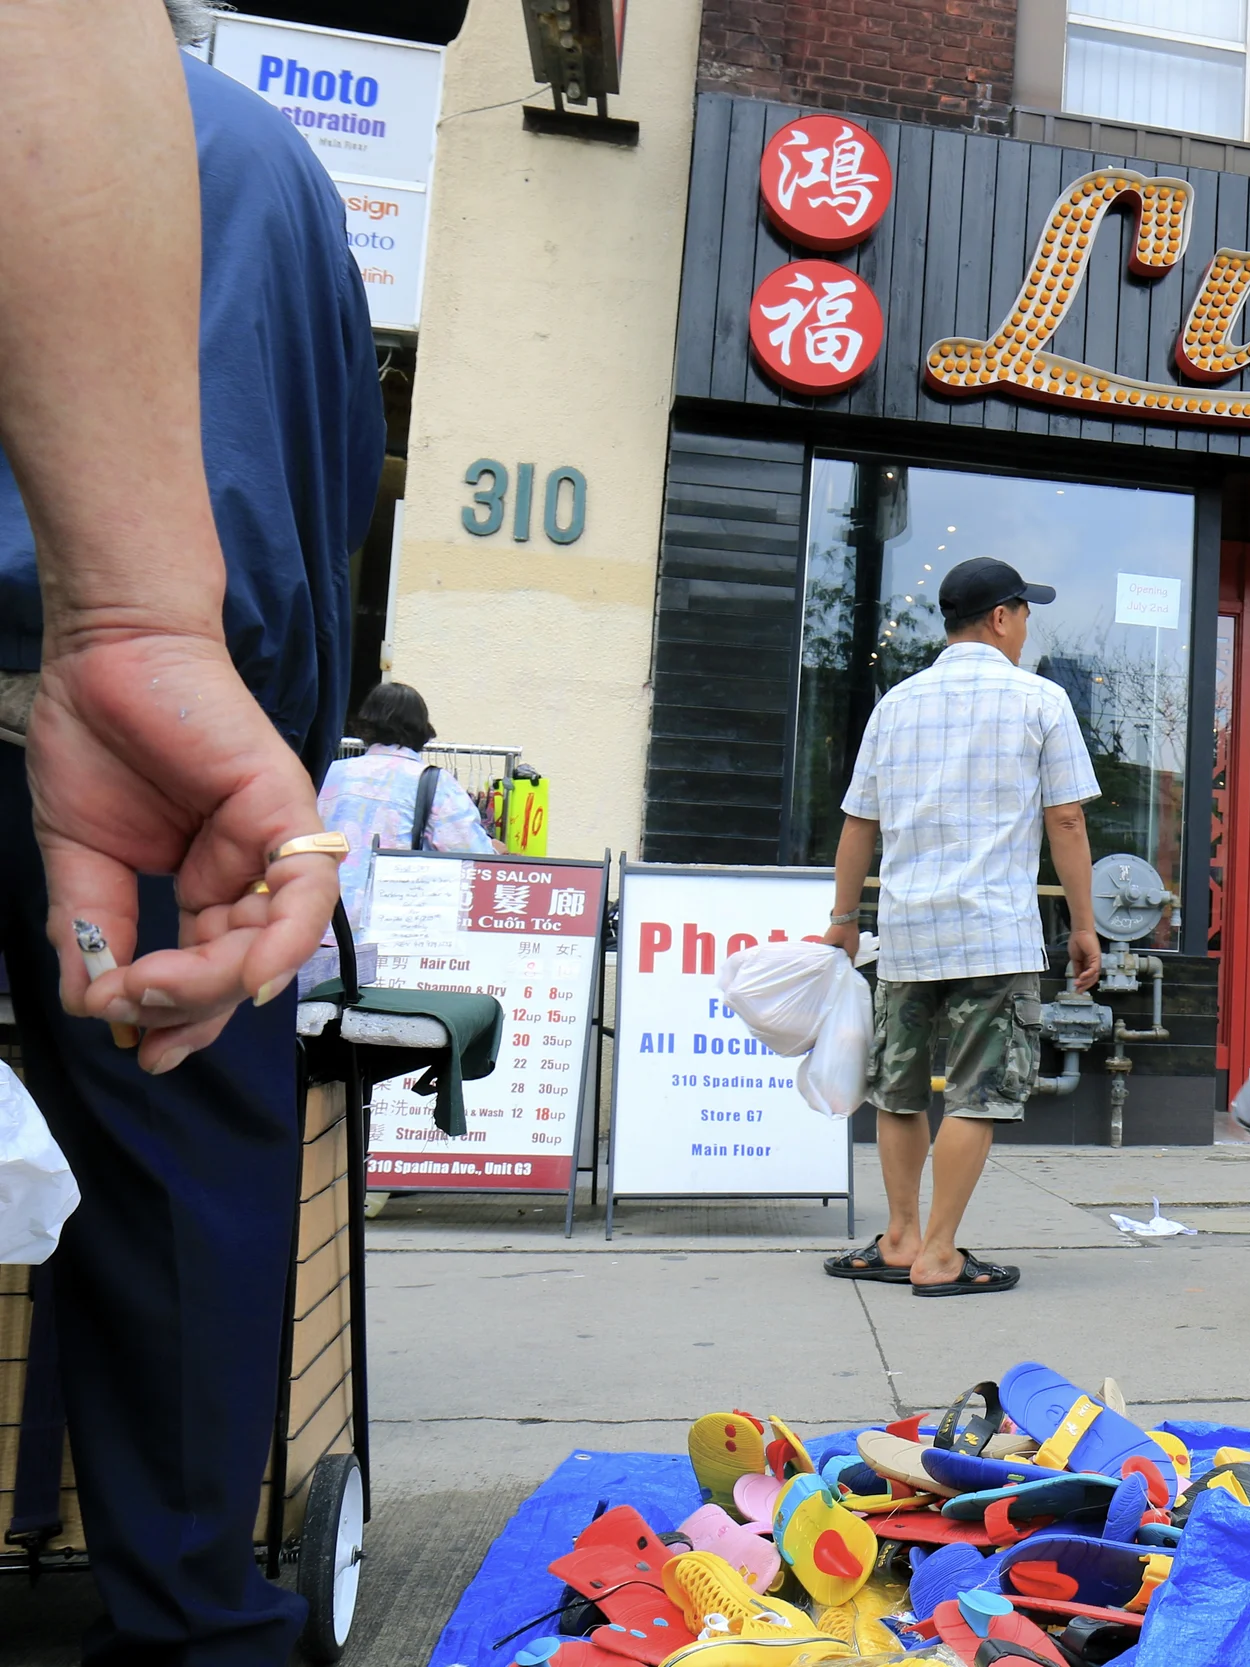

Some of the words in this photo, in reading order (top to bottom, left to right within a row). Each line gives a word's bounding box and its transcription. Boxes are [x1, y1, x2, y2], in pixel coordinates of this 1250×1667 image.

[258, 54, 379, 107] Photo
[281, 106, 386, 138] storation
[343, 195, 399, 220] sign
[347, 231, 395, 250] oto
[462, 458, 587, 545] 310
[1129, 583, 1168, 598] Opening
[1127, 601, 1147, 613] July
[1149, 603, 1169, 613] 2nd
[496, 870, 552, 884] SALON
[478, 915, 526, 929] Cuốn
[531, 917, 562, 931] Tóc
[638, 921, 826, 975] Pho
[420, 957, 446, 970] Hair
[449, 958, 471, 971] Cut
[487, 984, 507, 997] Dry
[524, 986, 533, 999] 6
[549, 987, 573, 1001] 8up
[512, 1008, 542, 1023] 12up
[547, 1009, 576, 1024] 15up
[709, 998, 735, 1019] Fo
[512, 1033, 530, 1047] 30
[542, 1035, 572, 1049] 35up
[639, 1032, 675, 1054] All
[513, 1058, 527, 1069] 22
[540, 1059, 570, 1073] 25up
[511, 1083, 525, 1093] 28
[538, 1083, 568, 1096] 30up
[672, 1074, 697, 1087] 310
[703, 1075, 763, 1089] Spadina
[768, 1076, 794, 1089] Ave
[479, 1108, 504, 1118] Wash
[511, 1107, 523, 1119] 12
[535, 1107, 566, 1121] 18up
[701, 1109, 741, 1122] Store
[747, 1110, 763, 1122] G7
[452, 1131, 487, 1142] erm
[531, 1132, 562, 1146] 90up
[691, 1143, 727, 1156] Main
[733, 1144, 771, 1157] Floor
[367, 1159, 393, 1173] 310
[394, 1160, 450, 1175] Spadina
[484, 1162, 512, 1176] Unit
[514, 1162, 532, 1176] G3
